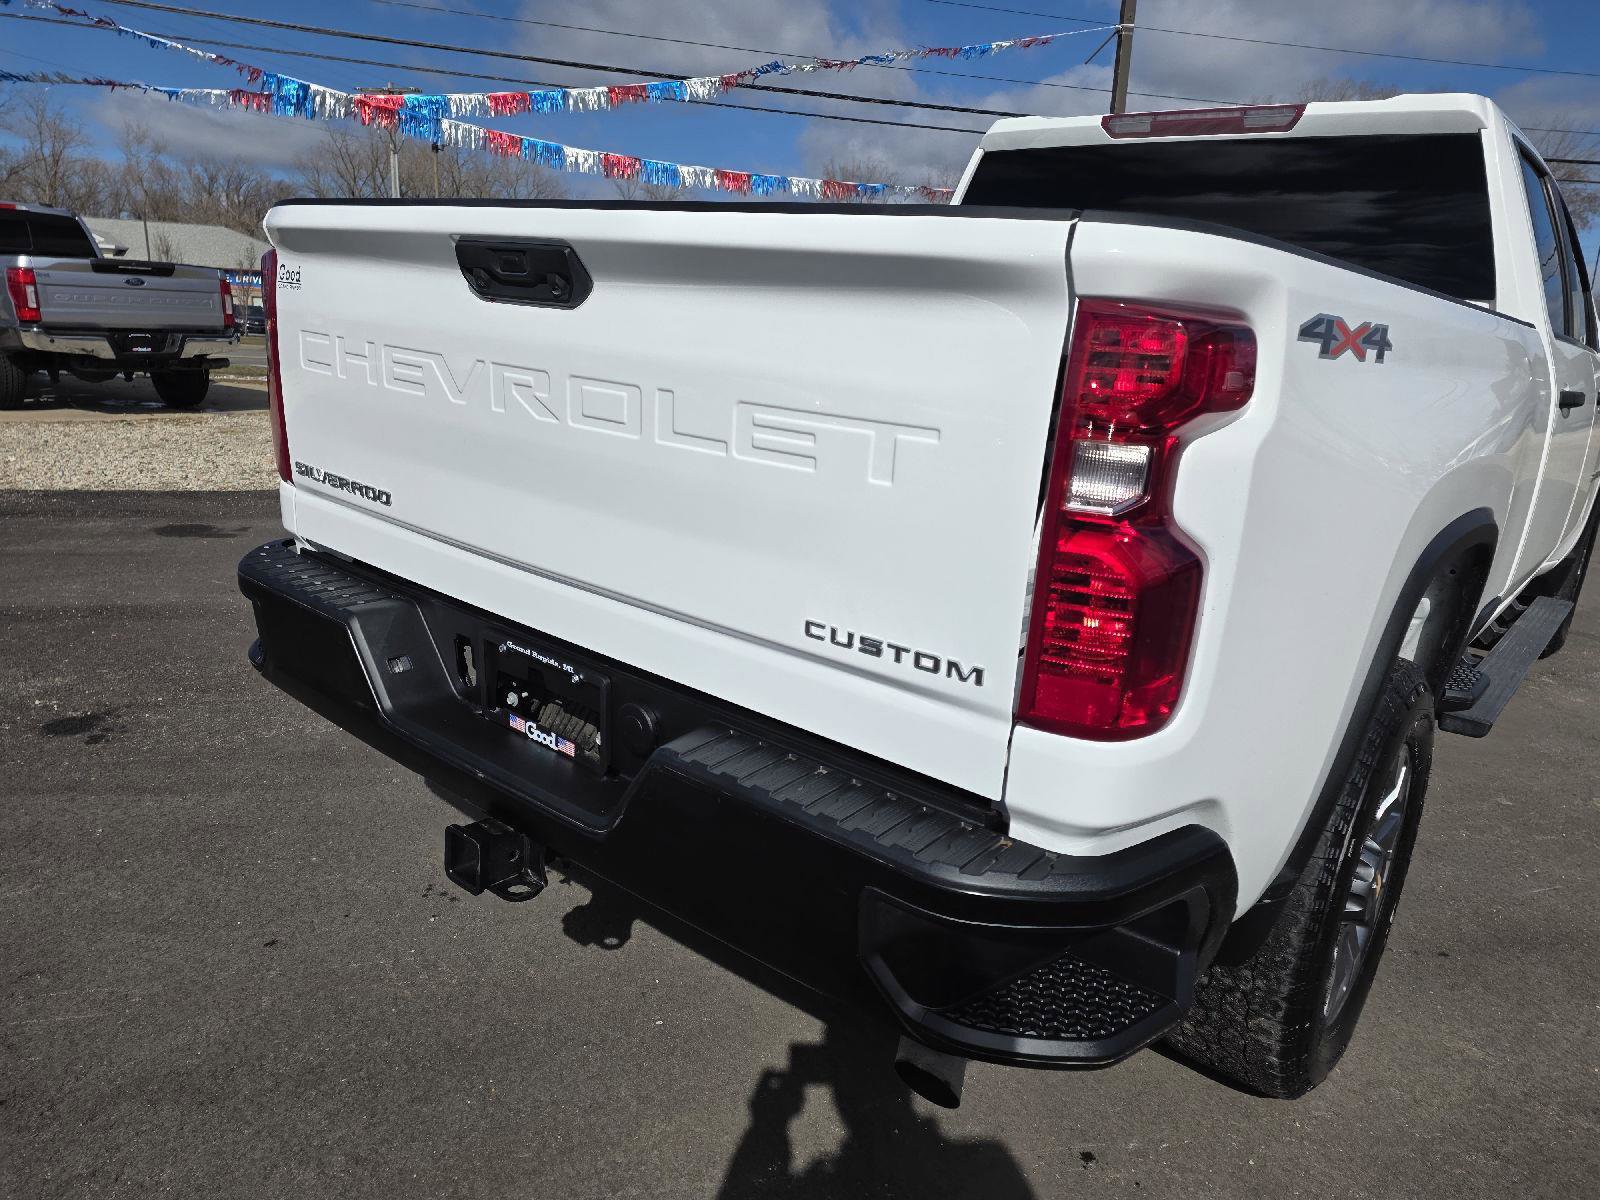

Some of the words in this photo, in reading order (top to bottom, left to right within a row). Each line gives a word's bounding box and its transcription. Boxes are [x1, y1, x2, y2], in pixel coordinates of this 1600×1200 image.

[279, 264, 301, 282] Good
[299, 330, 940, 487] CHEVROLET
[295, 461, 392, 506] SILVERADO
[506, 641, 531, 655] Grand
[804, 619, 985, 687] CUSTOM
[525, 721, 558, 751] Good
